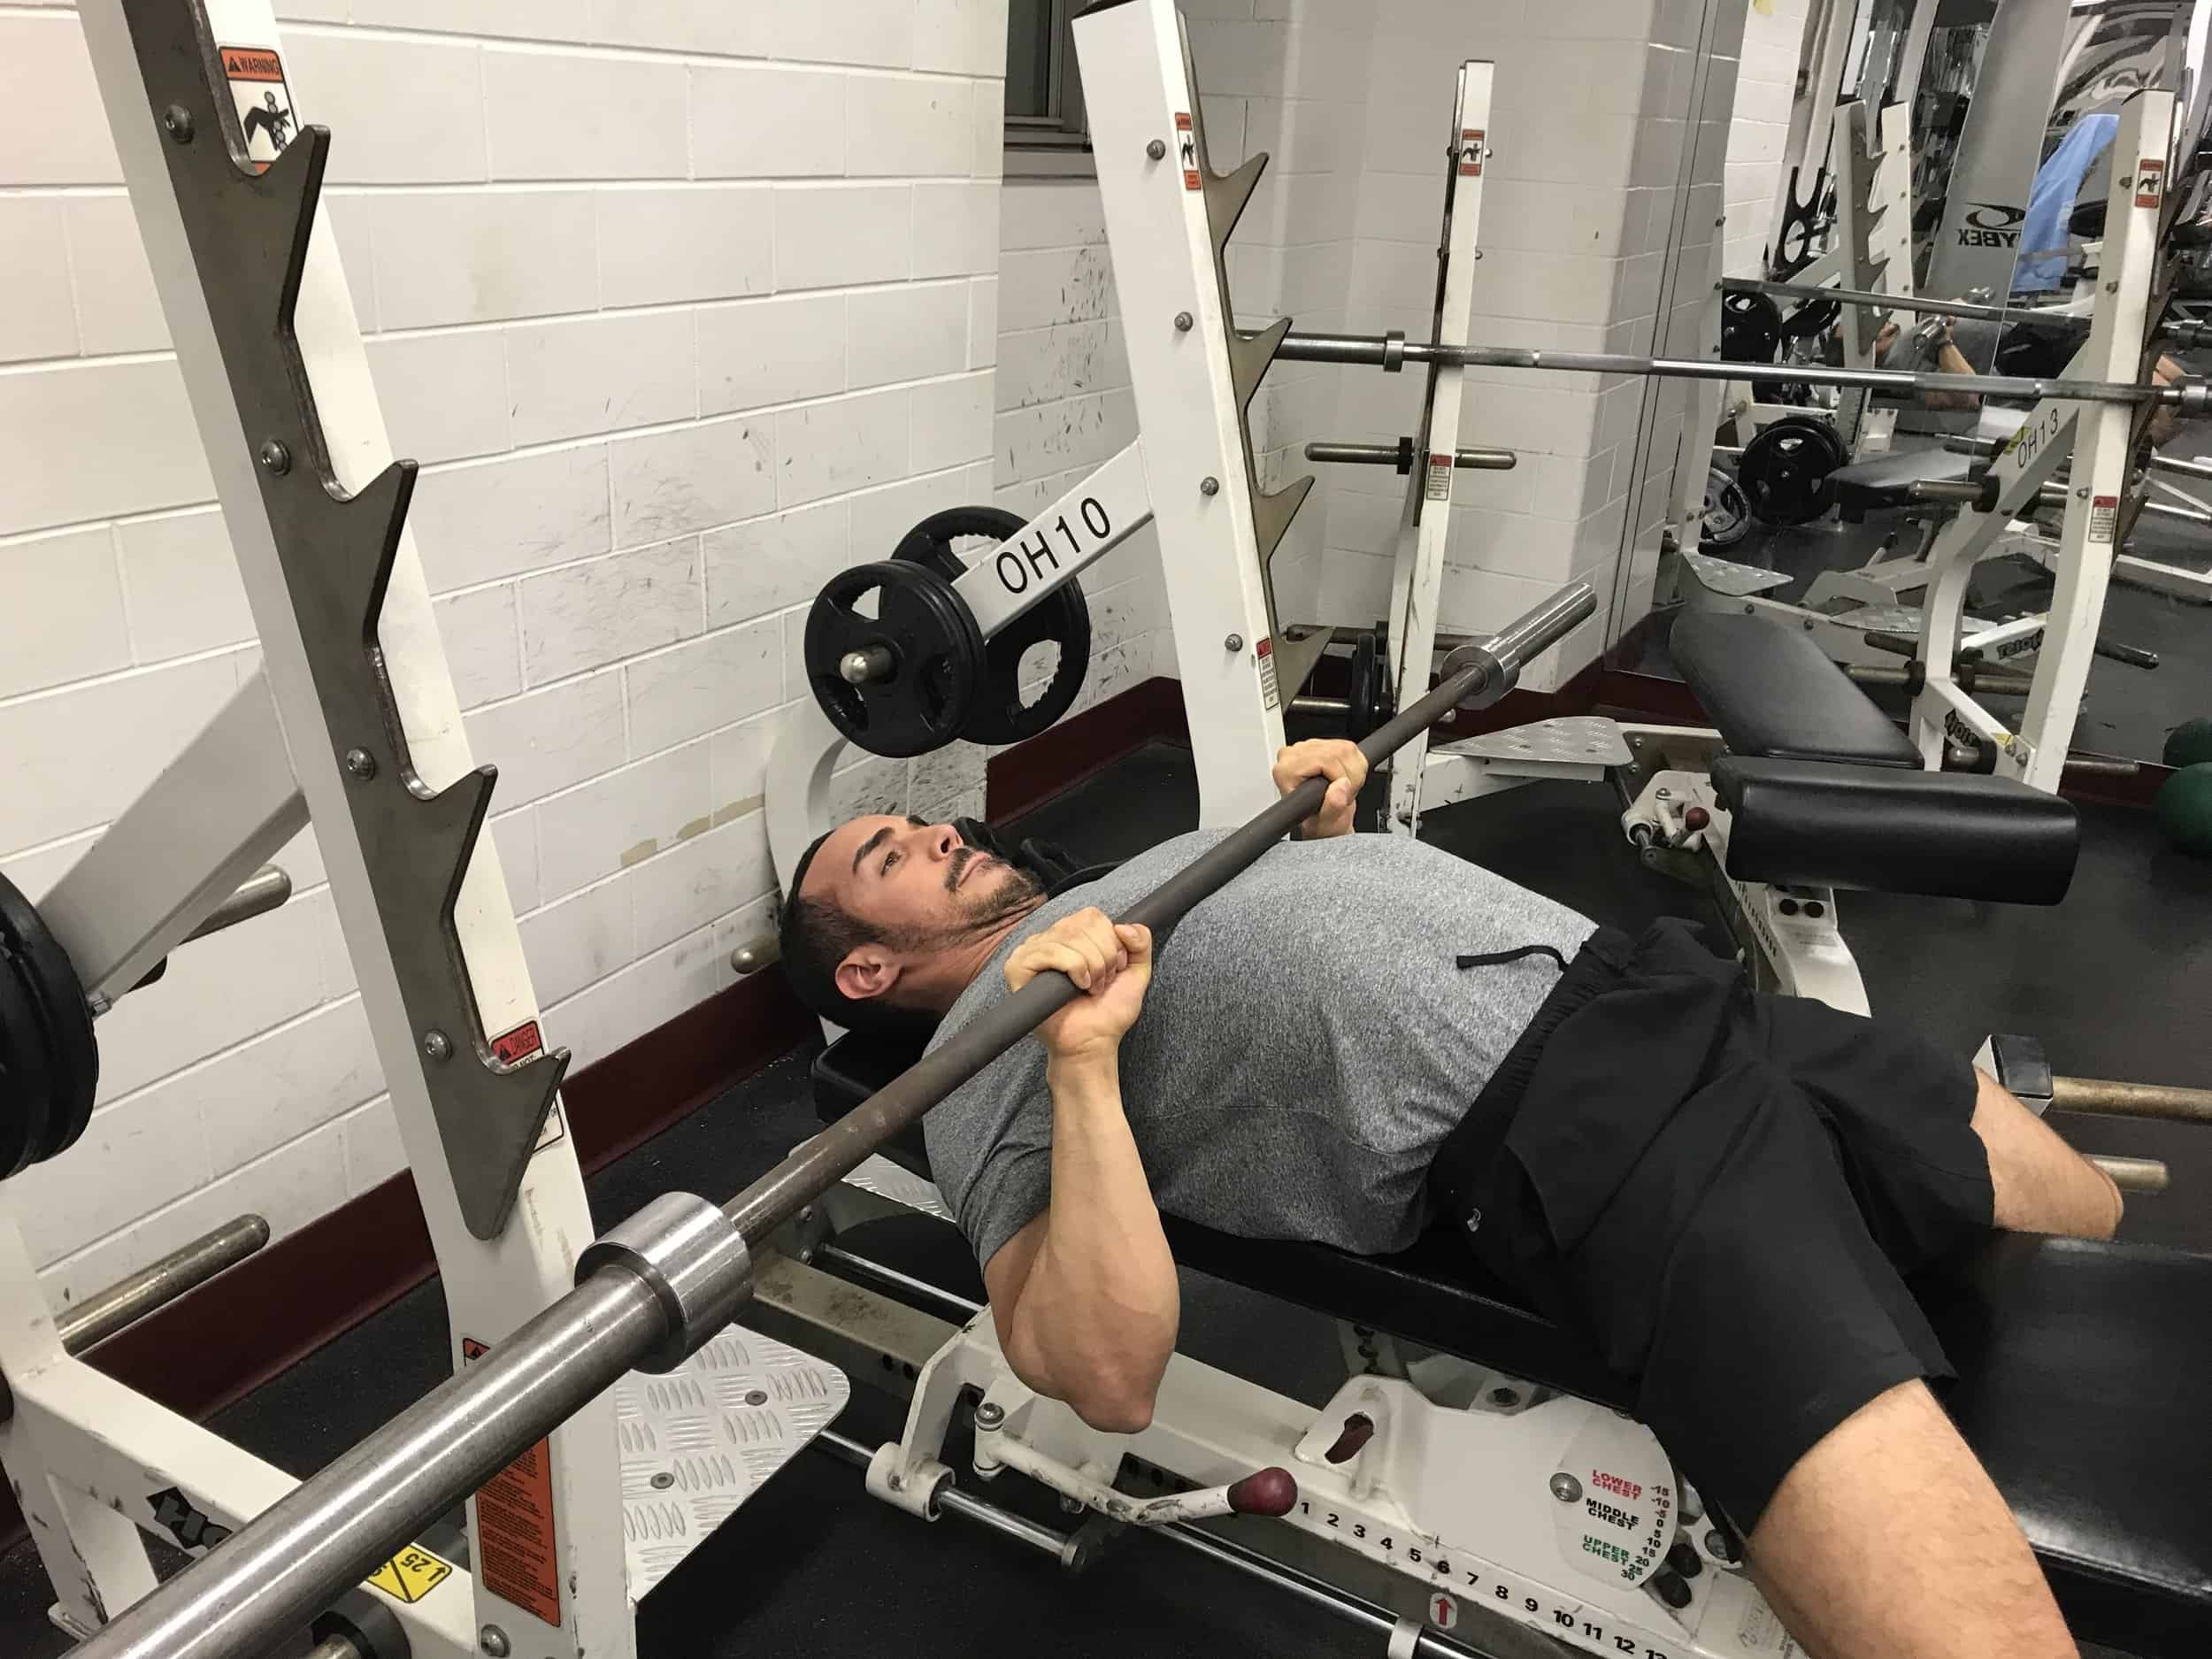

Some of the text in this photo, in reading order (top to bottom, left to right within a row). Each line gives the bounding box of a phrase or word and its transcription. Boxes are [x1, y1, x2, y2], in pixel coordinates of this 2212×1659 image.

[241, 57, 280, 75] WARNING
[996, 497, 1110, 594] OH10
[1593, 1469, 1642, 1494] LOWER
[1593, 1478, 1640, 1500] CHEST
[1586, 1498, 1640, 1525] MIDDLE
[1588, 1508, 1636, 1530] CHEST
[1656, 1518, 1664, 1528] 0
[1582, 1542, 1629, 1565] CHEST
[1583, 1534, 1630, 1559] UPPER
[1647, 1537, 1662, 1548] 10
[1301, 1502, 1310, 1515] 1
[1327, 1513, 1340, 1527] 2
[1353, 1525, 1365, 1538] 3
[1380, 1537, 1393, 1550] 4
[1409, 1548, 1421, 1563] 5
[1438, 1561, 1449, 1574] 6
[1467, 1571, 1479, 1585] 7
[1495, 1585, 1509, 1600] 8
[1525, 1598, 1538, 1612] 9
[1554, 1610, 1574, 1627] 10
[1583, 1623, 1602, 1640] 11
[1614, 1636, 1635, 1655] 12
